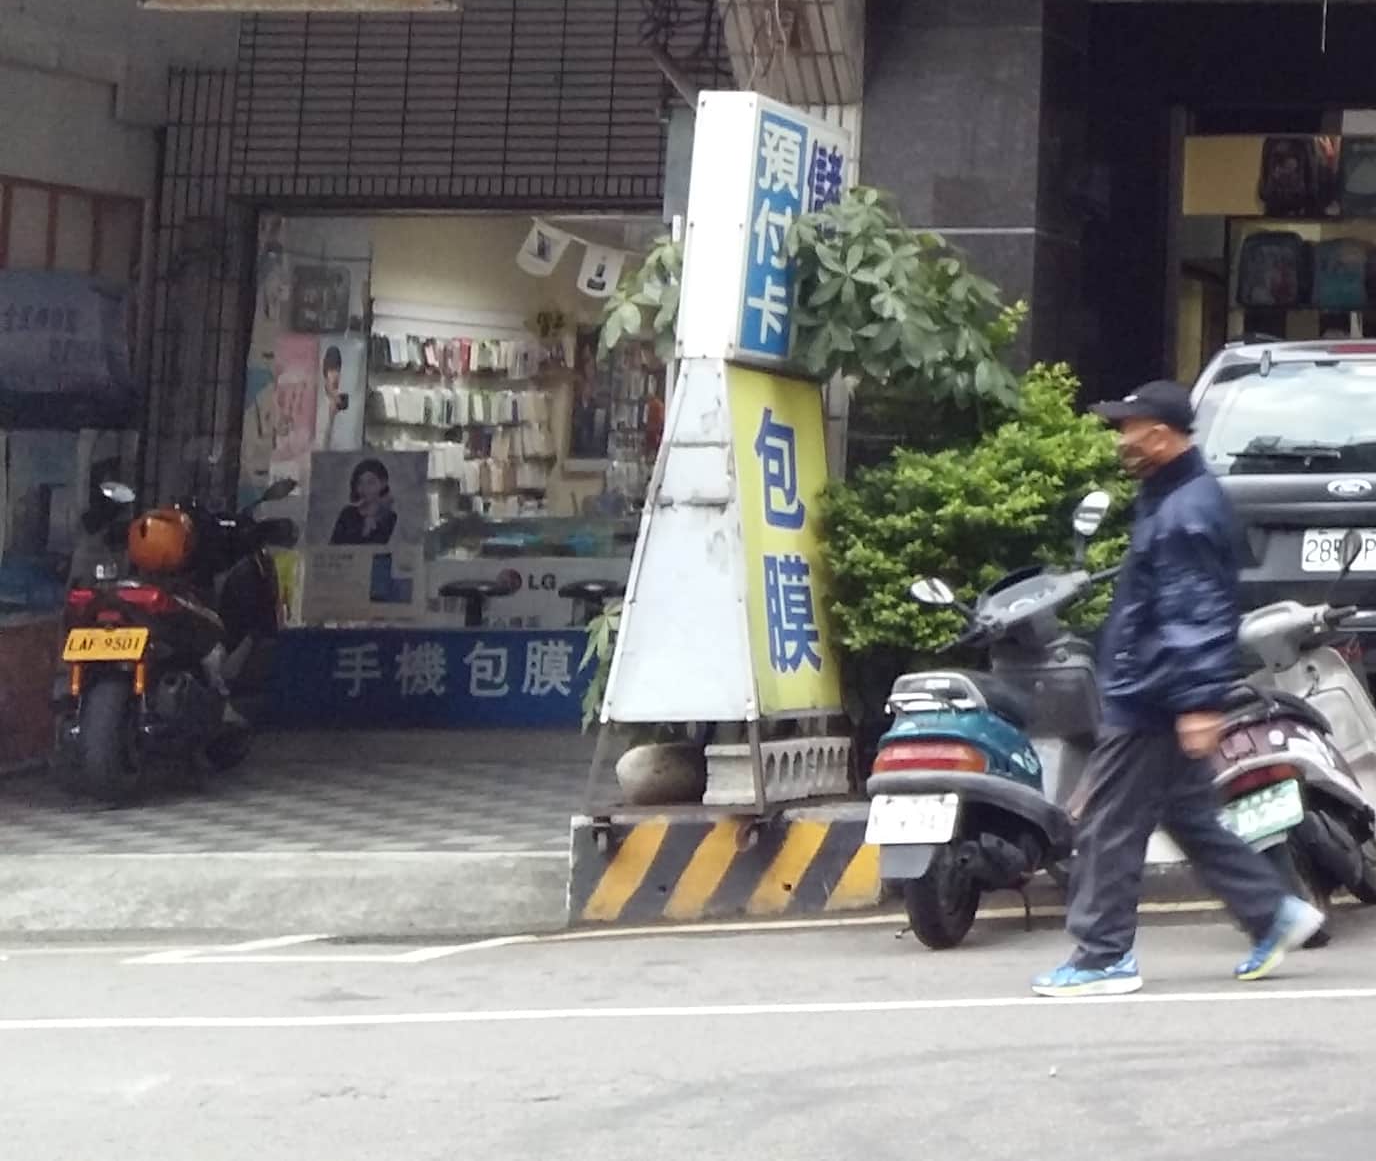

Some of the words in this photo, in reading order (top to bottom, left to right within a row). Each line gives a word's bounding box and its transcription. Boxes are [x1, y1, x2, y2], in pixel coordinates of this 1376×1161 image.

[747, 120, 803, 344] 預付卡
[528, 573, 556, 591] LG
[755, 405, 823, 674] 包膜
[332, 640, 573, 698] 手機包膜
